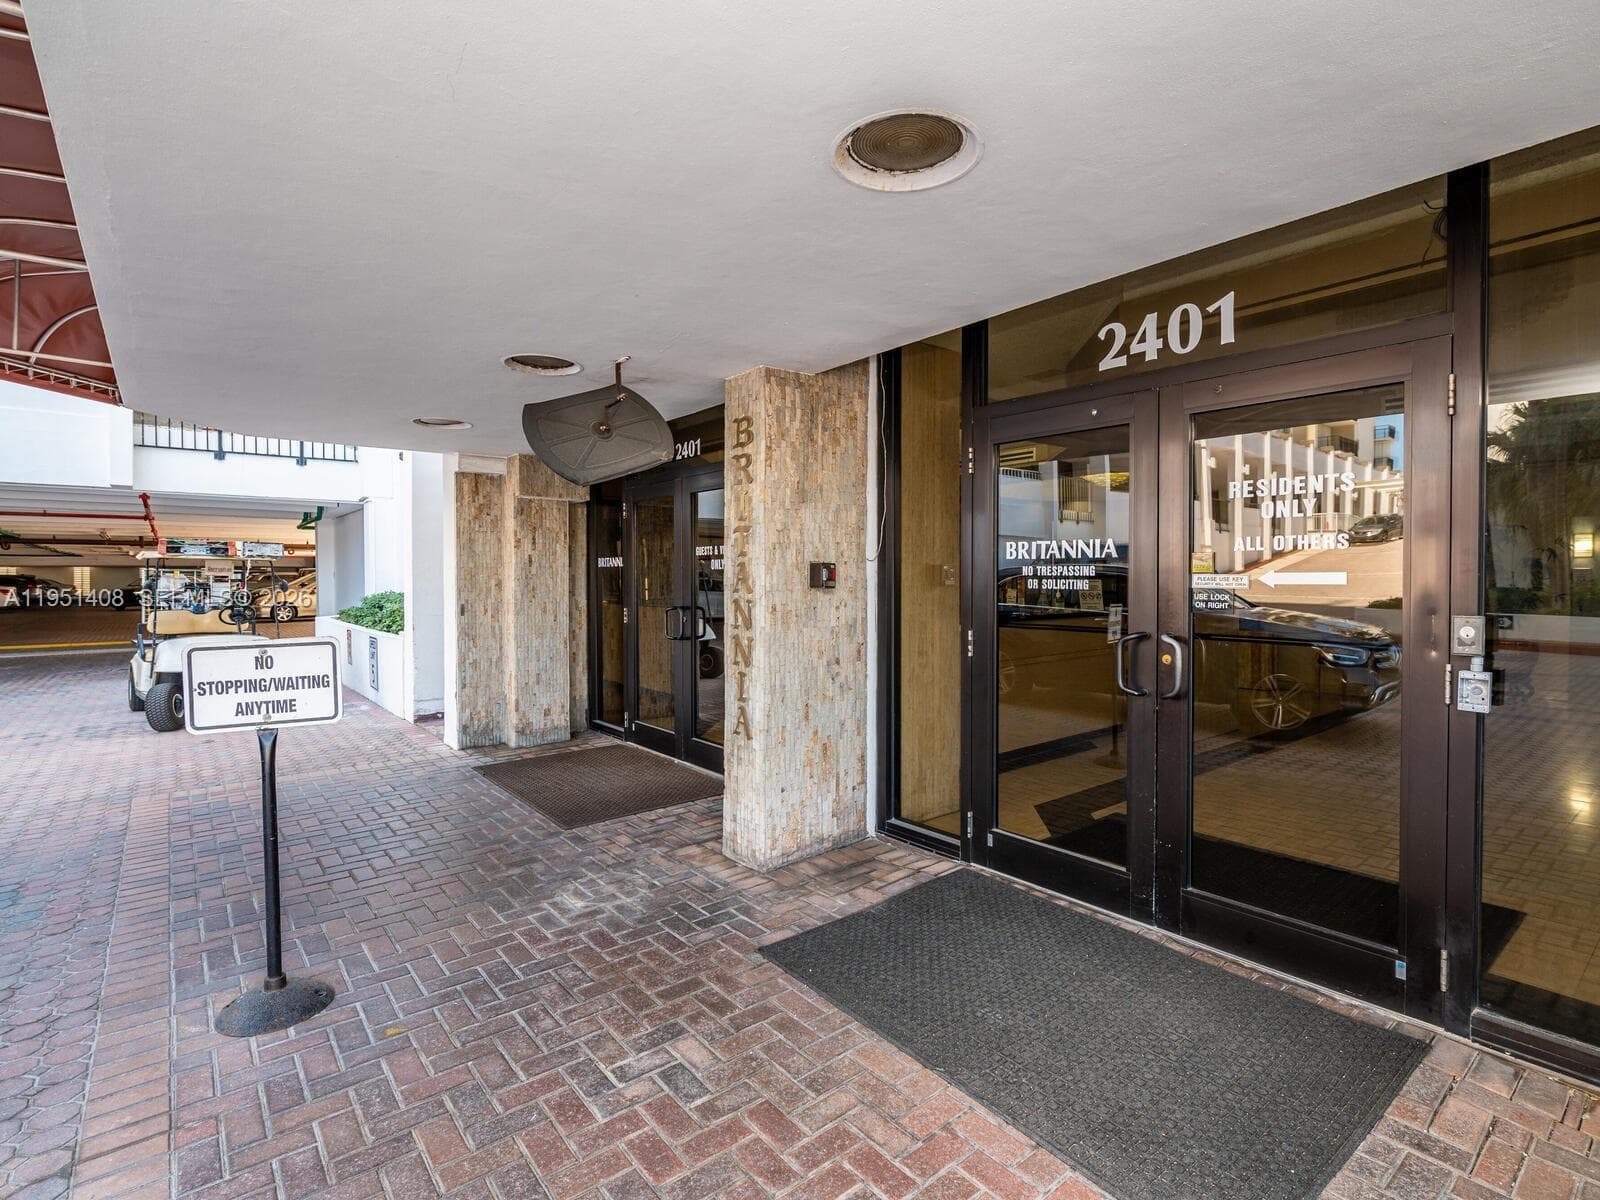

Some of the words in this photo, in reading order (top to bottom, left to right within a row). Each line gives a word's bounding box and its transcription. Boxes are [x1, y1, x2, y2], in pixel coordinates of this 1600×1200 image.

[1097, 290, 1236, 372] 2401
[675, 437, 701, 460] 2401
[1228, 472, 1356, 499] RESIDENTS
[1261, 498, 1317, 519] ONLY
[696, 546, 713, 556] GUESTS
[1005, 538, 1119, 560] BRITANNIA
[1233, 536, 1264, 551] ALL
[1273, 533, 1350, 550] OTHERS
[598, 556, 624, 568] BRITANNI
[1022, 566, 1034, 576] NO
[1036, 565, 1096, 577] TRESPASSING
[732, 416, 754, 741] BRITANNIA
[1027, 579, 1039, 590] OR
[1041, 579, 1089, 590] SOLICITING
[1210, 593, 1230, 601] LOCK
[254, 655, 274, 670] NO
[197, 674, 330, 696] STOPPING/WAITING
[235, 699, 297, 717] ANYTIME
